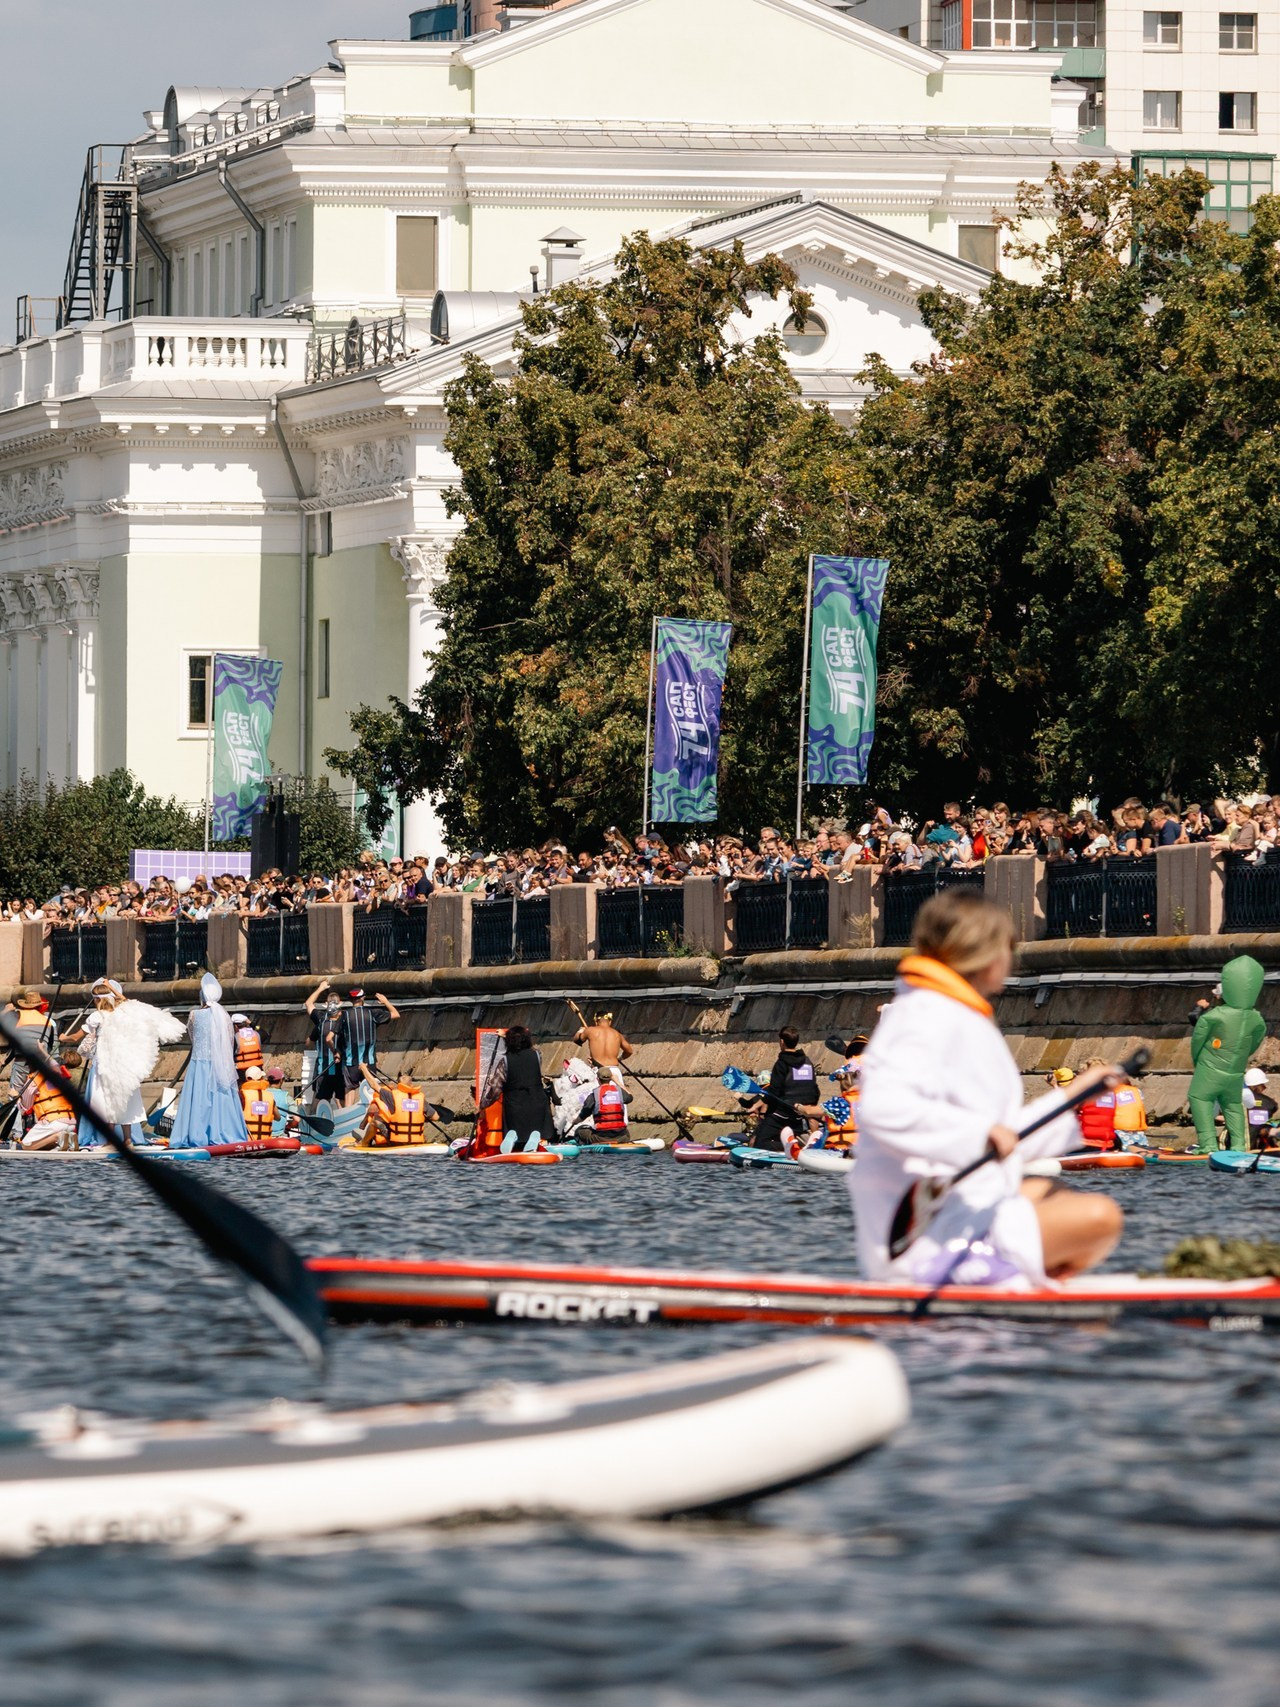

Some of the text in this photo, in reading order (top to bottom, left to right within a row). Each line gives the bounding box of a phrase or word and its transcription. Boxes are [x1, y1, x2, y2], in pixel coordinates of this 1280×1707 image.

[838, 671, 865, 714] 74
[680, 720, 710, 760] 74
[236, 748, 262, 784] 74
